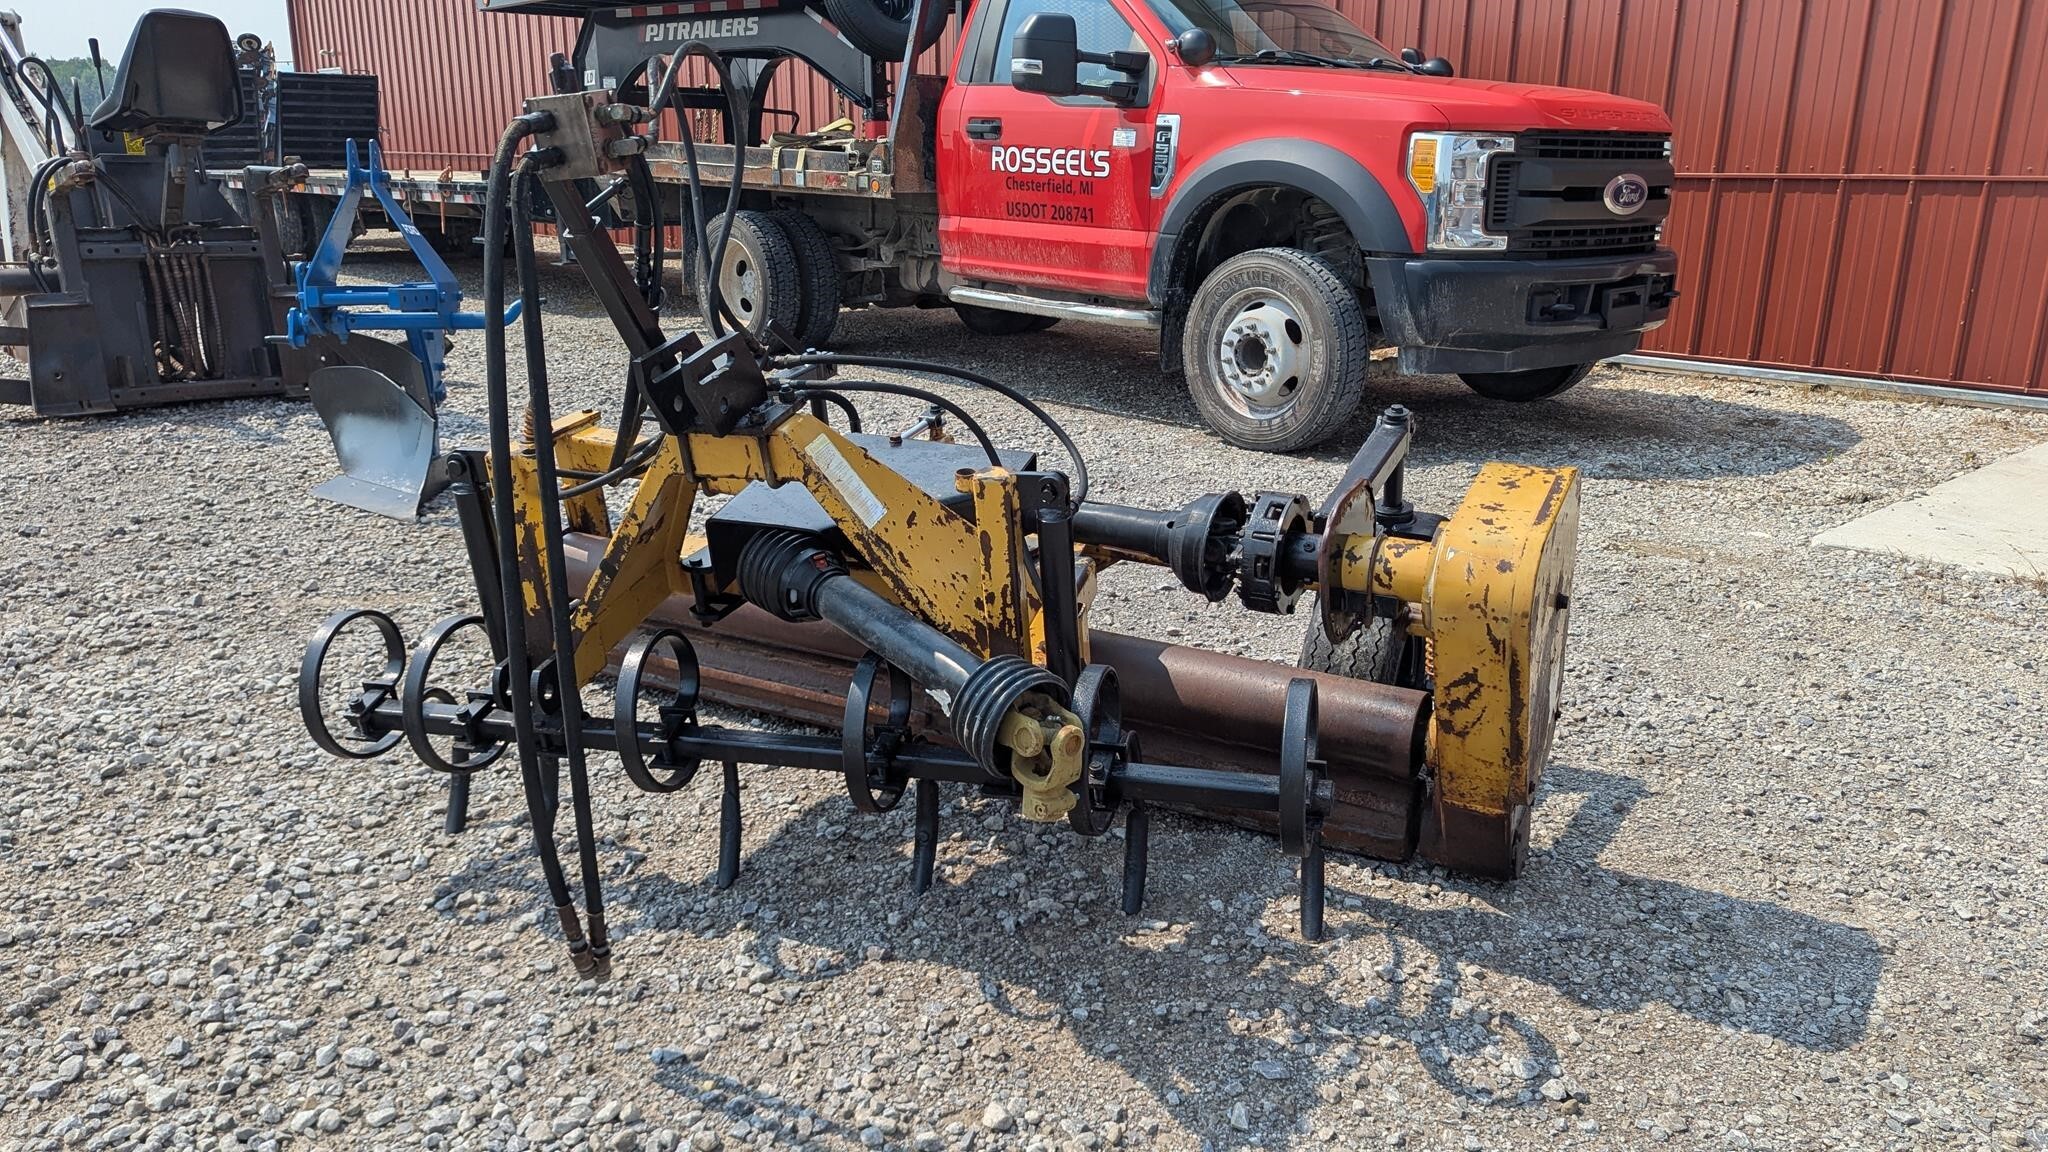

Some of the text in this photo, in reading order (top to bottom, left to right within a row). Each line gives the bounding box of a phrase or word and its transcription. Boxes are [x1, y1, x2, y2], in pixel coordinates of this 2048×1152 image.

[991, 146, 1110, 177] ROSSEEL'S
[1006, 176, 1094, 196] Chesterfield, MI
[1619, 184, 1641, 203] Ford
[1006, 201, 1094, 223] USDOT 208741
